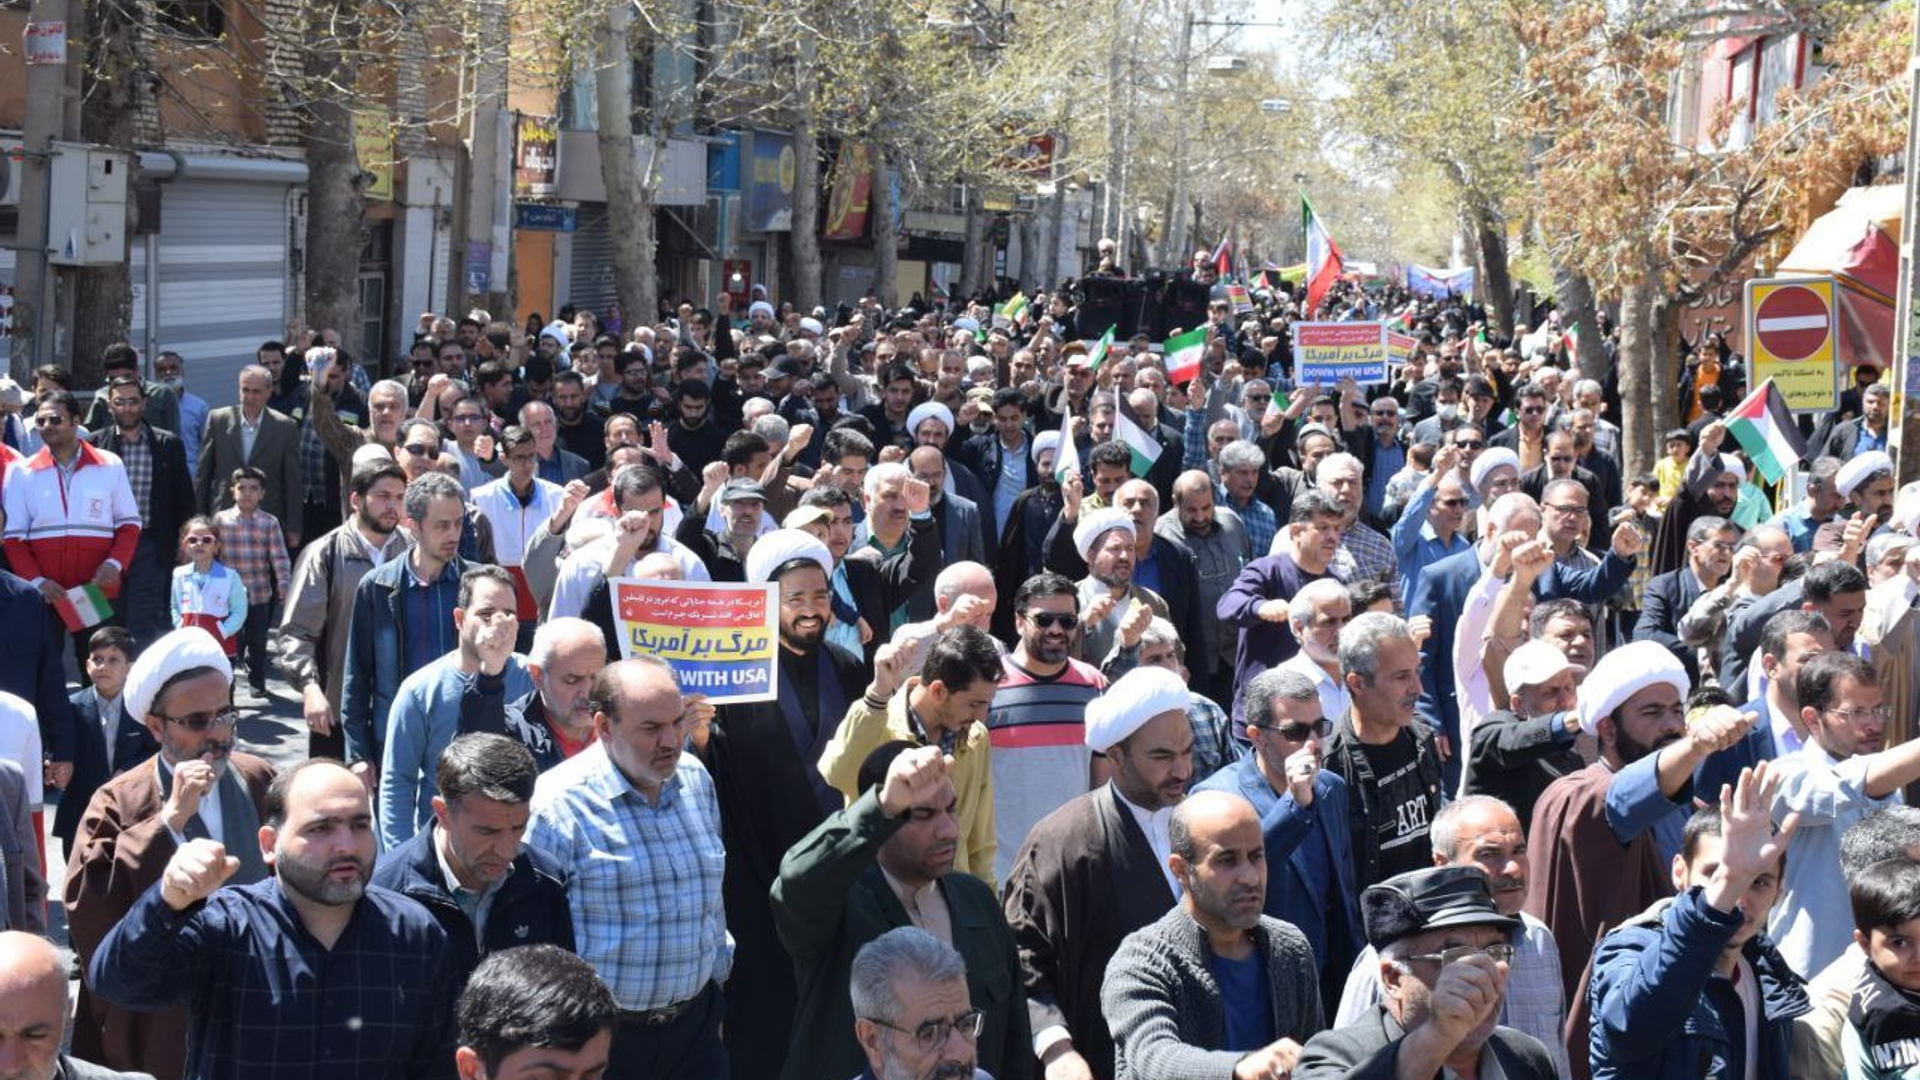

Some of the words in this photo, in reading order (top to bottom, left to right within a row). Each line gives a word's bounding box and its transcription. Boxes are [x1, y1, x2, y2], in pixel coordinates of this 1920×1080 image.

[1305, 347, 1341, 359] آمریکا
[1343, 350, 1357, 361] بر
[1358, 347, 1383, 359] مرگ
[1303, 367, 1335, 377] DOWN
[1335, 366, 1362, 376] WITH
[1363, 366, 1383, 375] USA
[632, 627, 690, 656] آمریکا
[690, 638, 713, 659] بر
[715, 630, 770, 656] مرگ
[680, 669, 728, 687] WITH
[732, 668, 768, 685] USA
[1396, 794, 1428, 836] ART
